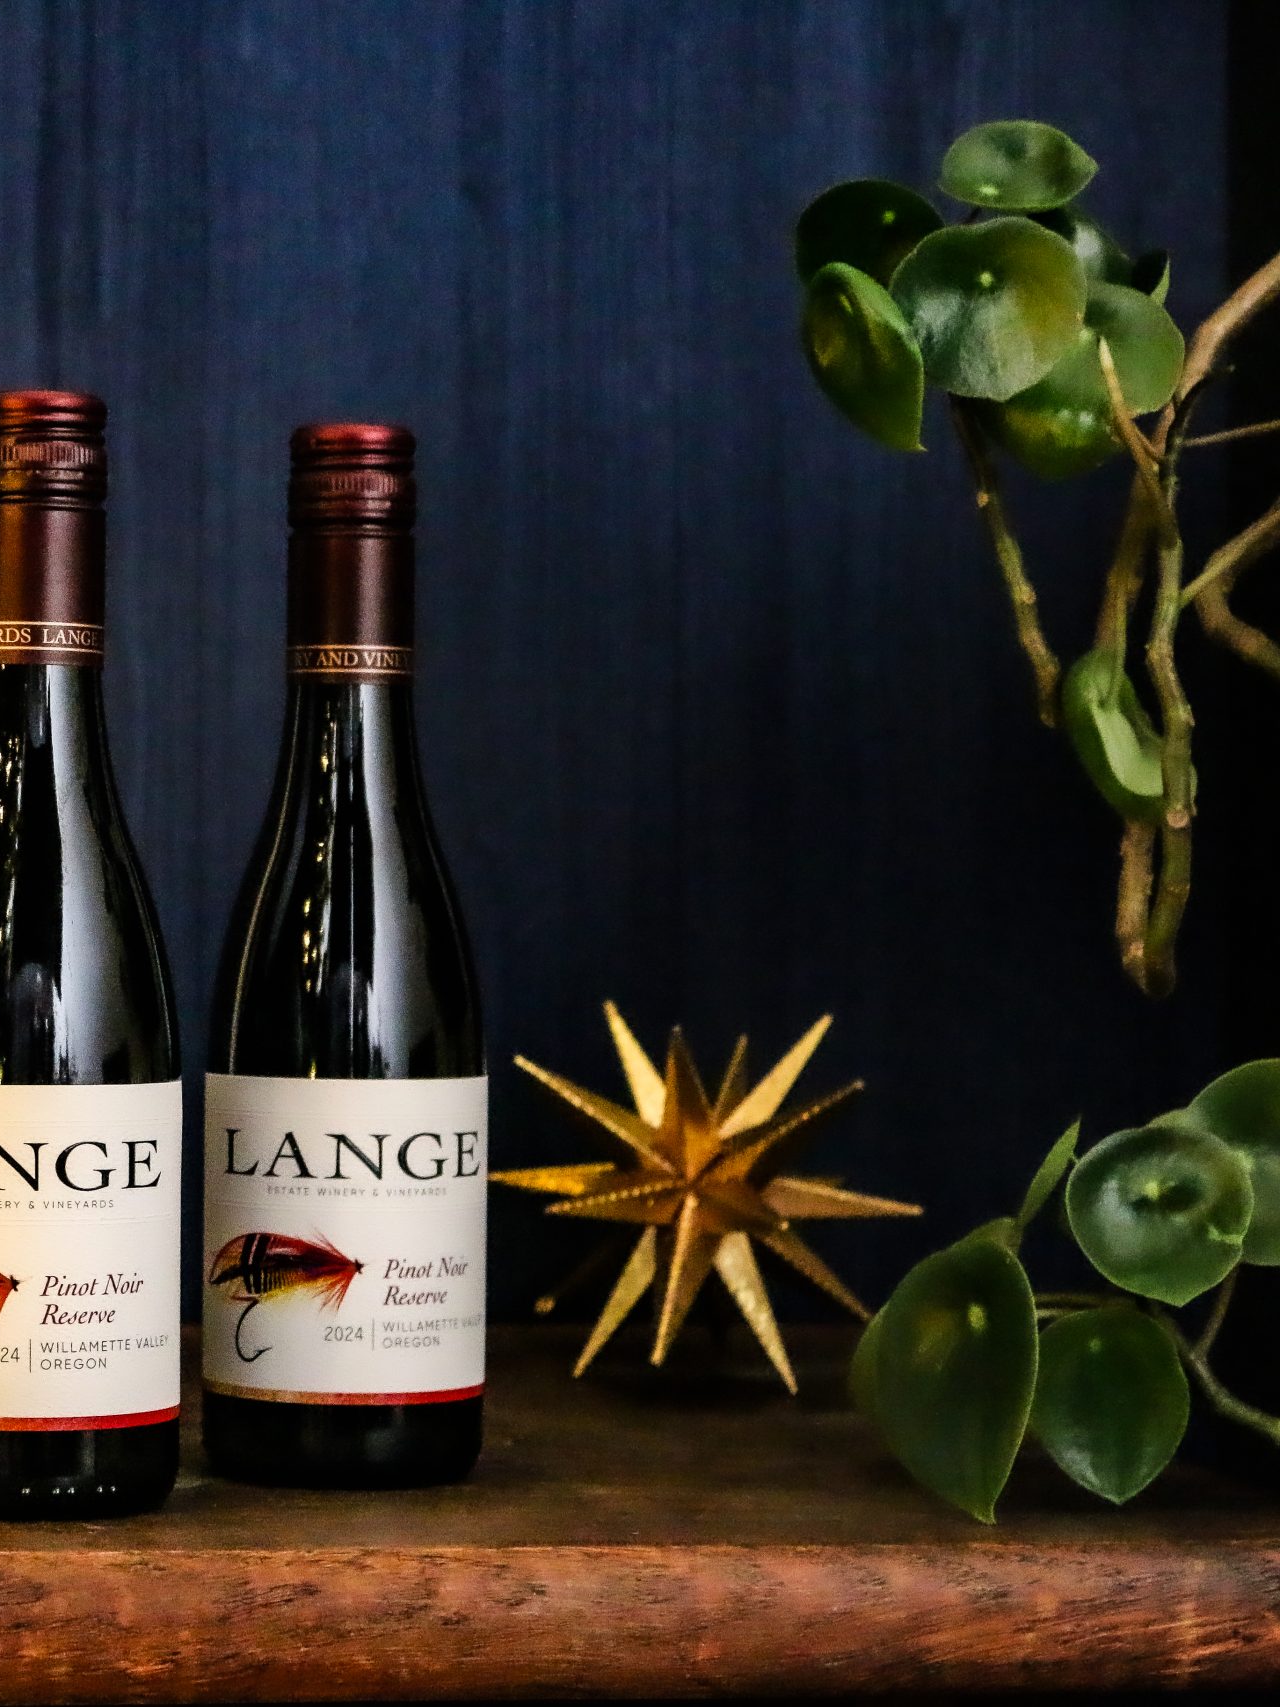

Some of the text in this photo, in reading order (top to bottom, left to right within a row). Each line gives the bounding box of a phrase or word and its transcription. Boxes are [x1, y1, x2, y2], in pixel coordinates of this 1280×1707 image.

[42, 628, 98, 646] LANGE
[317, 651, 359, 666] AND
[224, 1128, 481, 1181] LANGE
[28, 1200, 35, 1209] &
[43, 1199, 114, 1209] VINEYARDS
[383, 1255, 469, 1280] Pinot Noir
[40, 1272, 144, 1297] Pinot Noir
[383, 1284, 449, 1306] Reserve
[39, 1303, 116, 1325] Reserve
[323, 1325, 364, 1342] 2024
[382, 1318, 458, 1333] WILLAMETTE
[40, 1334, 169, 1353] WILLAMETTE VALLEY
[382, 1336, 440, 1349] OREGON
[40, 1357, 108, 1370] OREGON
